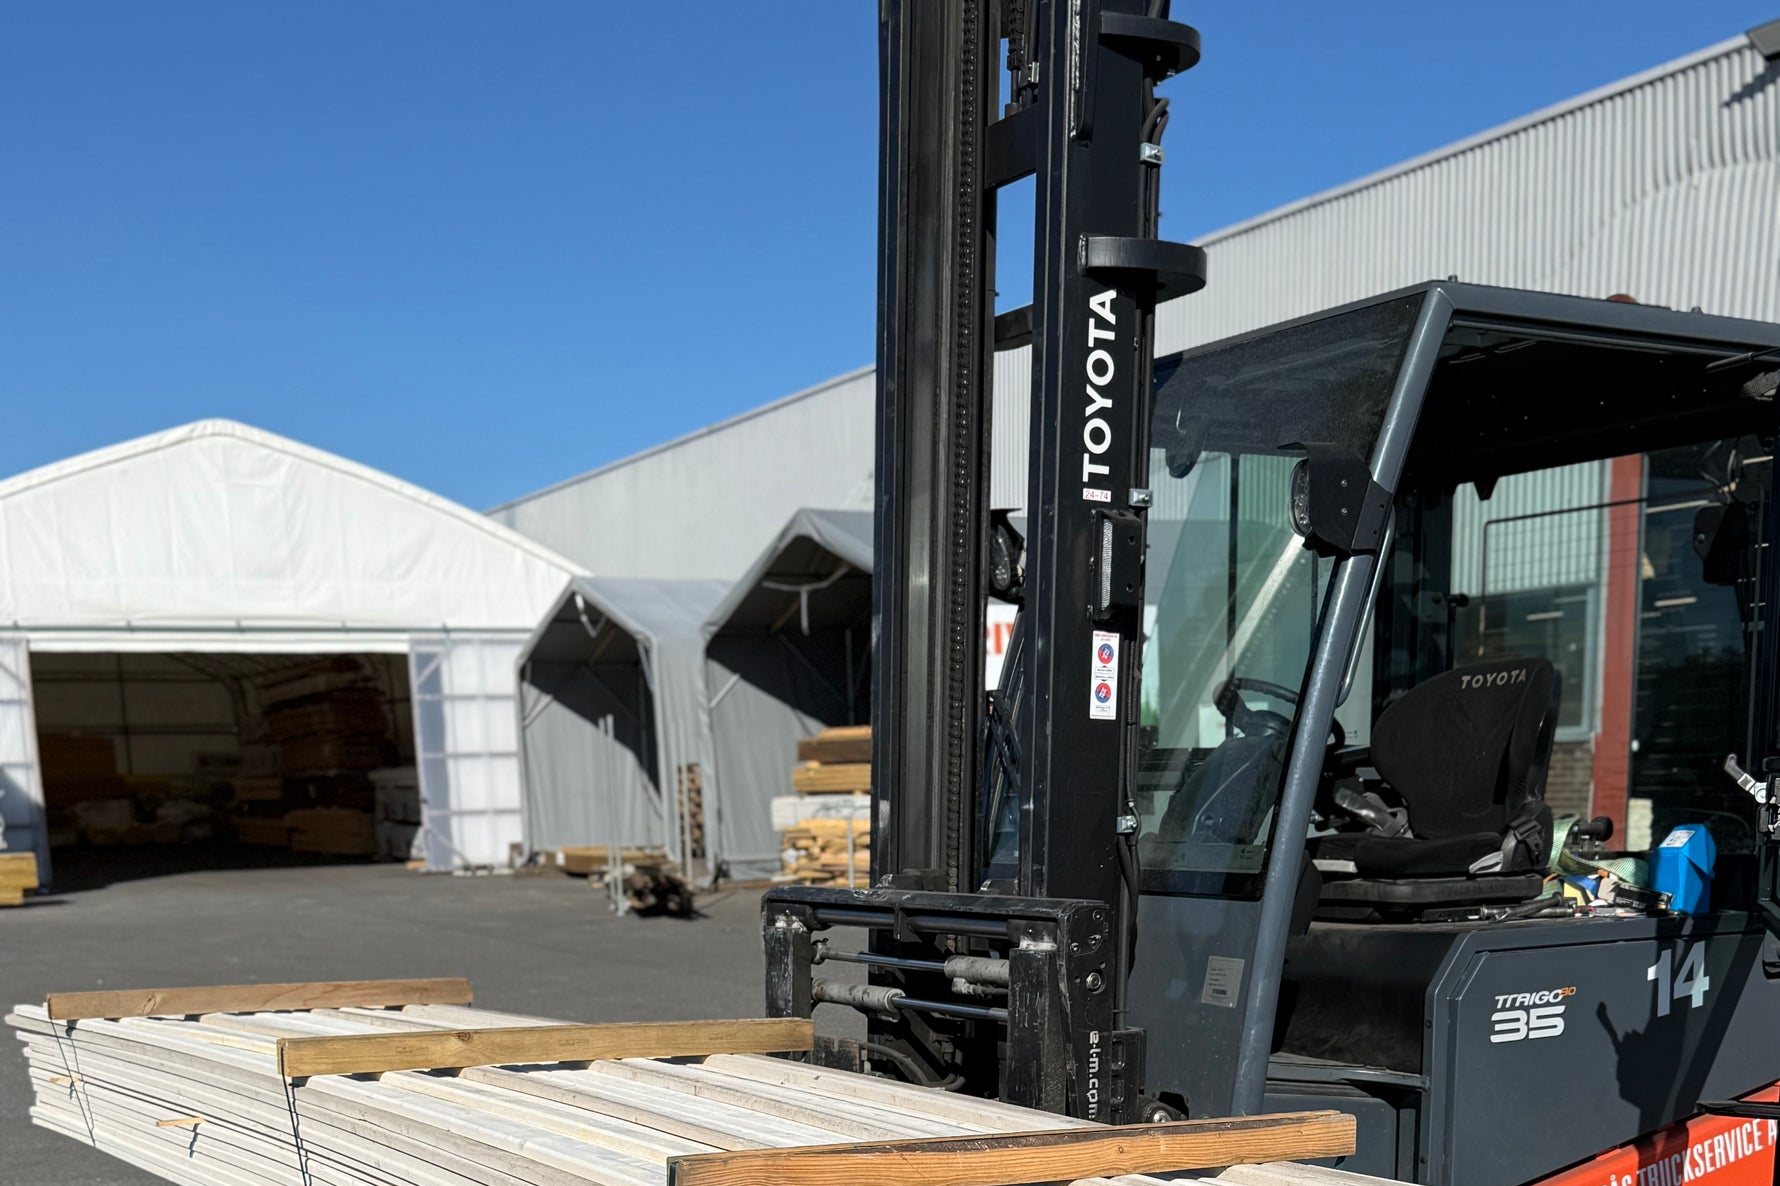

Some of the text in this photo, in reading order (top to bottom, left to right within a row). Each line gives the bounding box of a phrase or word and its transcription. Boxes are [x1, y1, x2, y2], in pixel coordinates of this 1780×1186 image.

[1082, 289, 1117, 483] TOYOTA
[1085, 489, 1109, 501] 24-74
[1461, 668, 1526, 689] TOYOTA
[1647, 940, 1710, 1018] 14
[1490, 1005, 1566, 1043] 35
